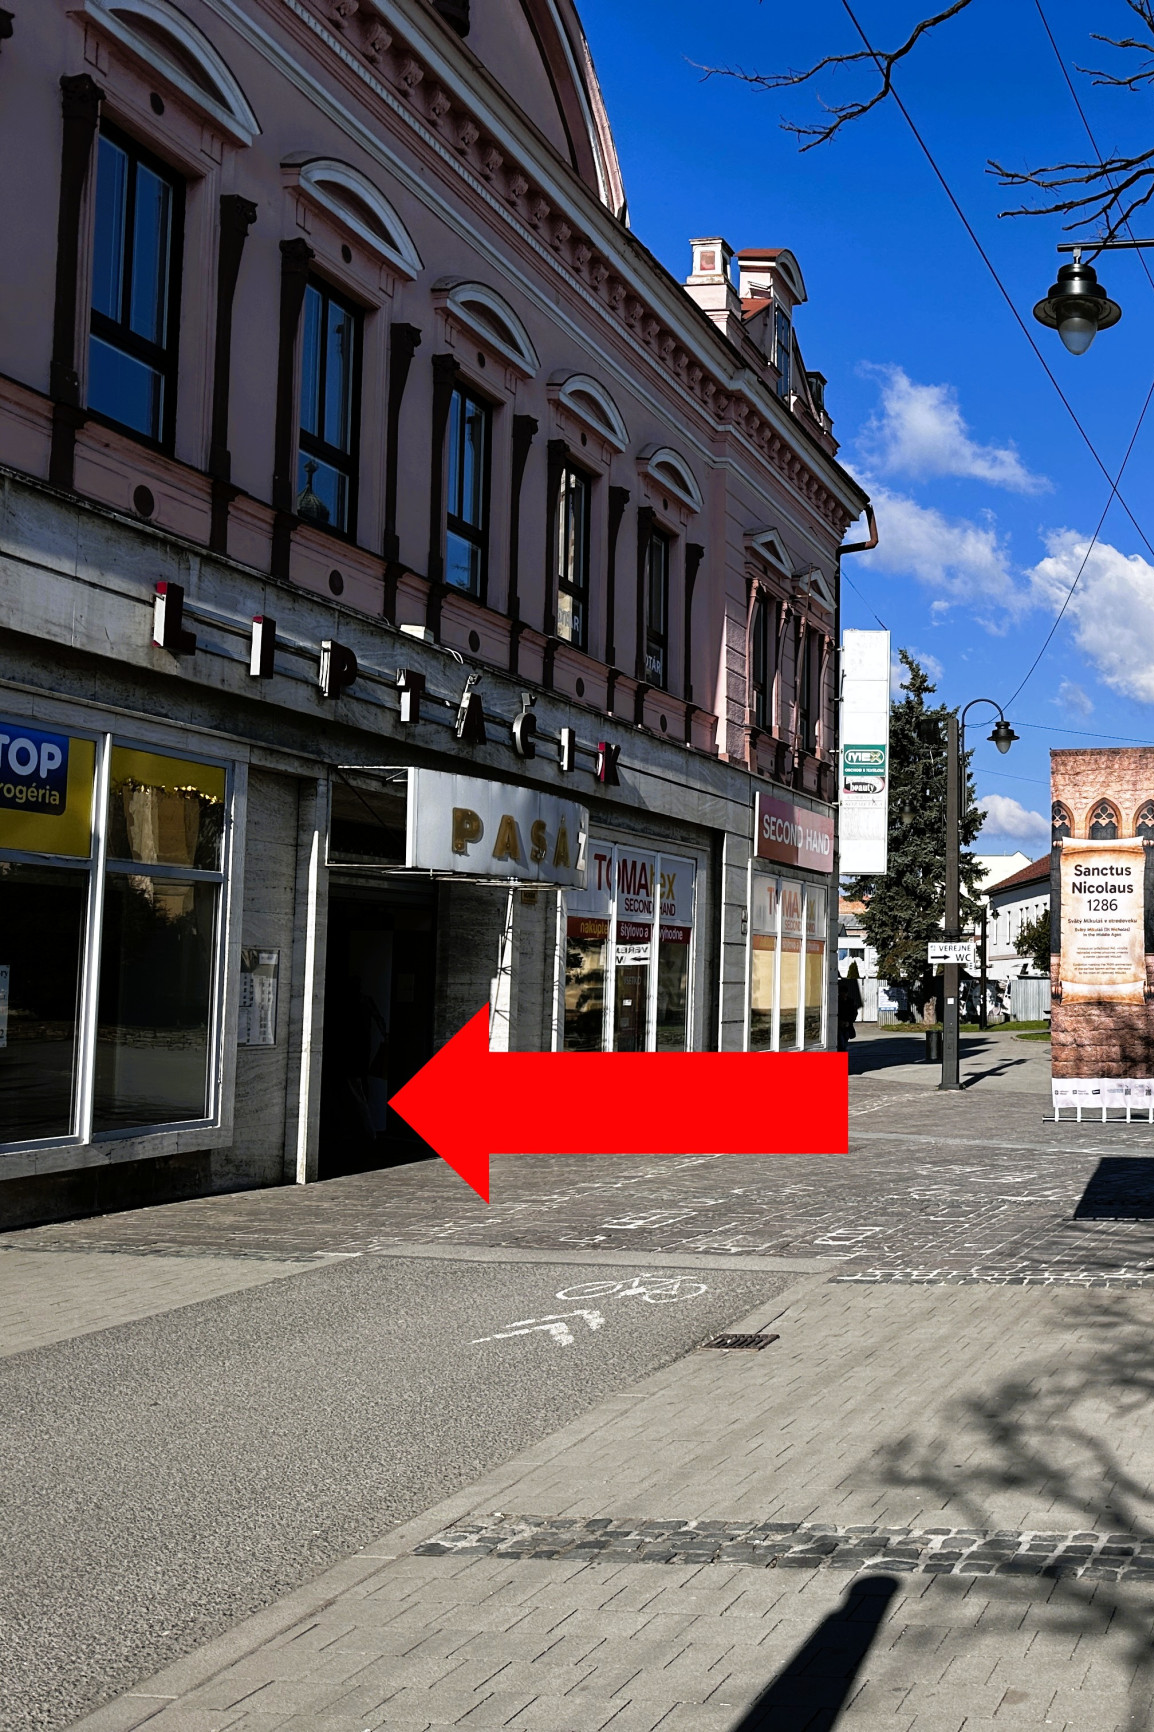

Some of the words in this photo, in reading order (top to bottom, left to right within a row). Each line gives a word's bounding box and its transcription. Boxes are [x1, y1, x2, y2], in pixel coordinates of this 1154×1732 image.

[152, 581, 621, 786] LIPTÁČIK
[847, 751, 882, 764] MEX
[850, 780, 875, 794] beauty
[763, 814, 803, 848] SECOND
[806, 828, 830, 856] HAND
[1074, 864, 1132, 877] Sanctus
[1072, 881, 1134, 894] Nicolaus
[1087, 898, 1118, 911] 1286
[955, 953, 971, 961] WC
